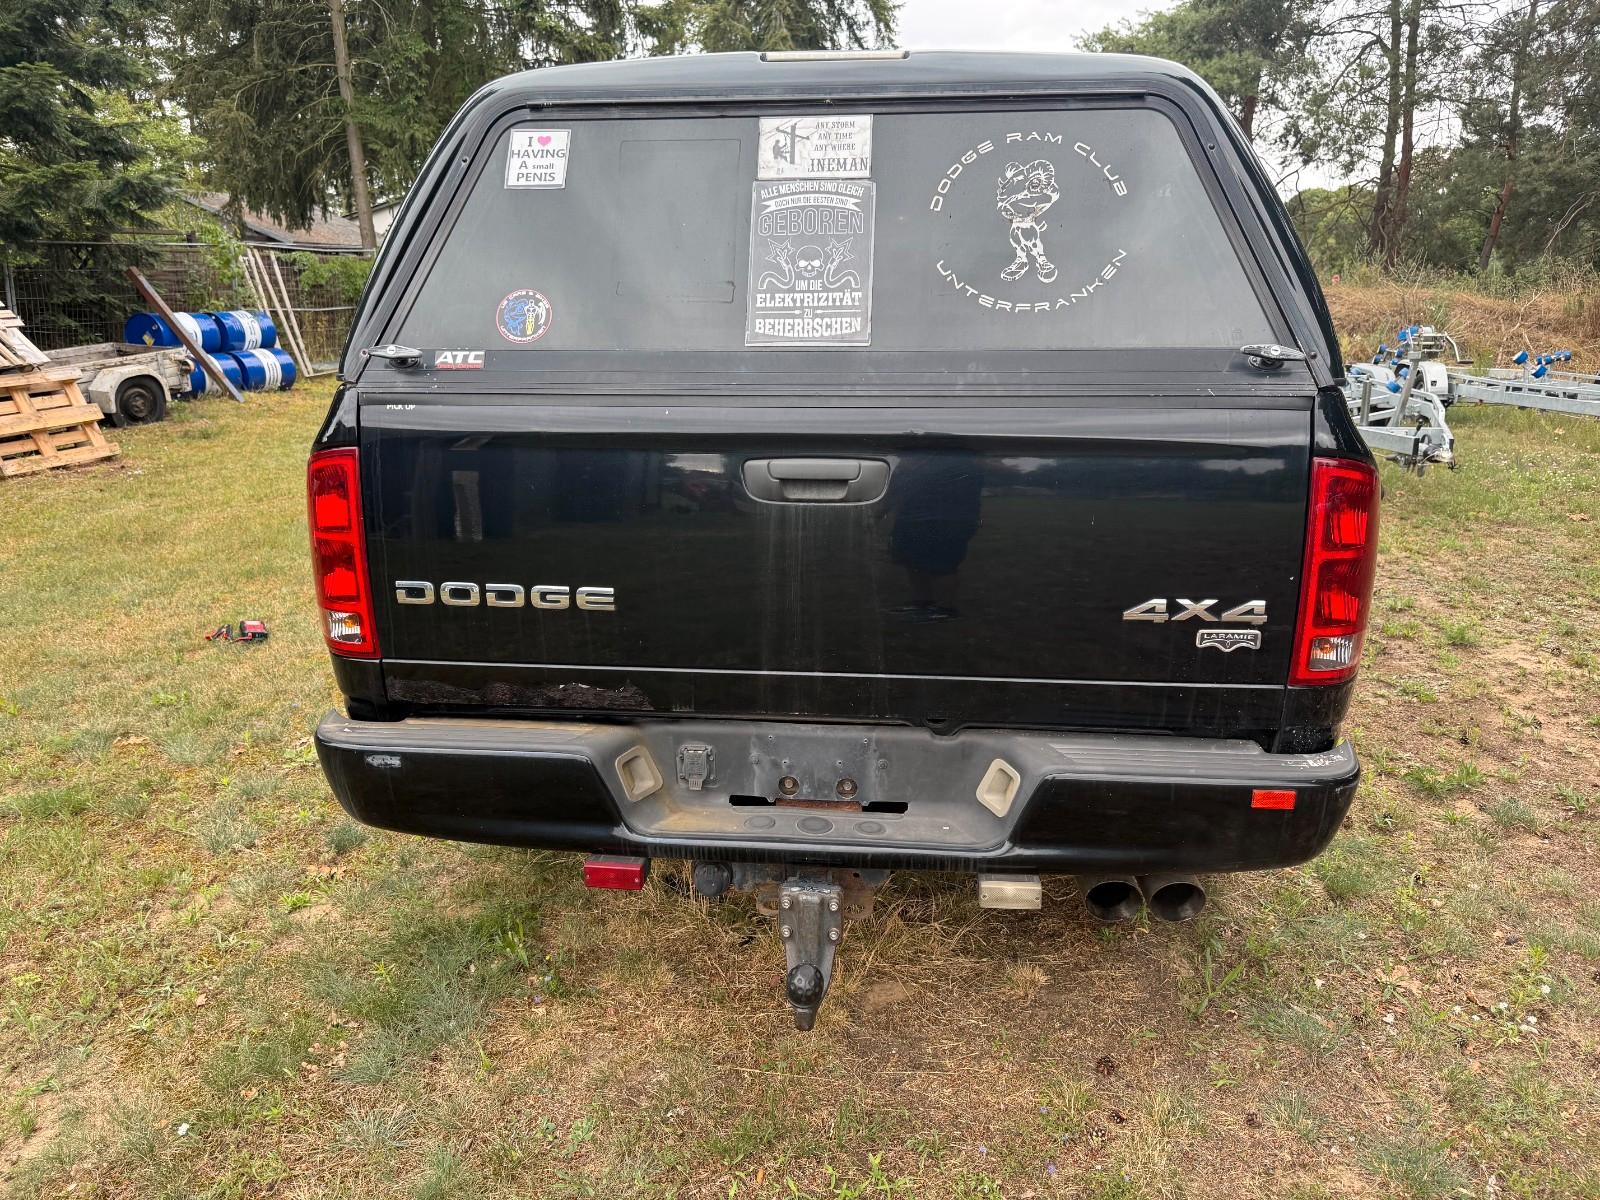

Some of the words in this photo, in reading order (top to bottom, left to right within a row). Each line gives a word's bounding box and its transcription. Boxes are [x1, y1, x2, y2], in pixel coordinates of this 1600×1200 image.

[815, 121, 830, 129] ANY
[832, 120, 855, 128] STORM
[527, 136, 534, 147] I
[818, 132, 832, 140] ANY
[834, 132, 853, 140] TIME
[831, 143, 856, 151] WHERE
[511, 149, 566, 159] HAVING
[518, 160, 528, 170] A
[532, 162, 555, 170] small
[808, 157, 869, 172] INEMAN
[516, 172, 556, 182] PENIS
[930, 140, 995, 212] DODGE
[1006, 131, 1063, 144] RAM
[1073, 141, 1128, 197] CLUB
[760, 186, 778, 199] ALLE
[779, 181, 818, 194] MENSCHEN
[819, 181, 837, 192] SIND
[838, 182, 865, 197] GLEICH
[774, 197, 790, 208] DOCH
[790, 196, 803, 205] NUR
[803, 196, 812, 204] DIE
[812, 196, 835, 205] BESTEN
[834, 197, 849, 206] SIND
[758, 208, 864, 236] GEBOREN
[795, 280, 808, 290] UM
[809, 279, 823, 290] DIE
[936, 248, 1128, 313] UNTERFRANKEN
[755, 289, 862, 307] ELEKTRIZITÄT
[803, 308, 813, 318] ZU
[754, 317, 862, 337] BEHERRSCHEN
[435, 351, 485, 364] ATC
[395, 580, 616, 611] DODGE
[1203, 633, 1256, 641] LARAMIE
